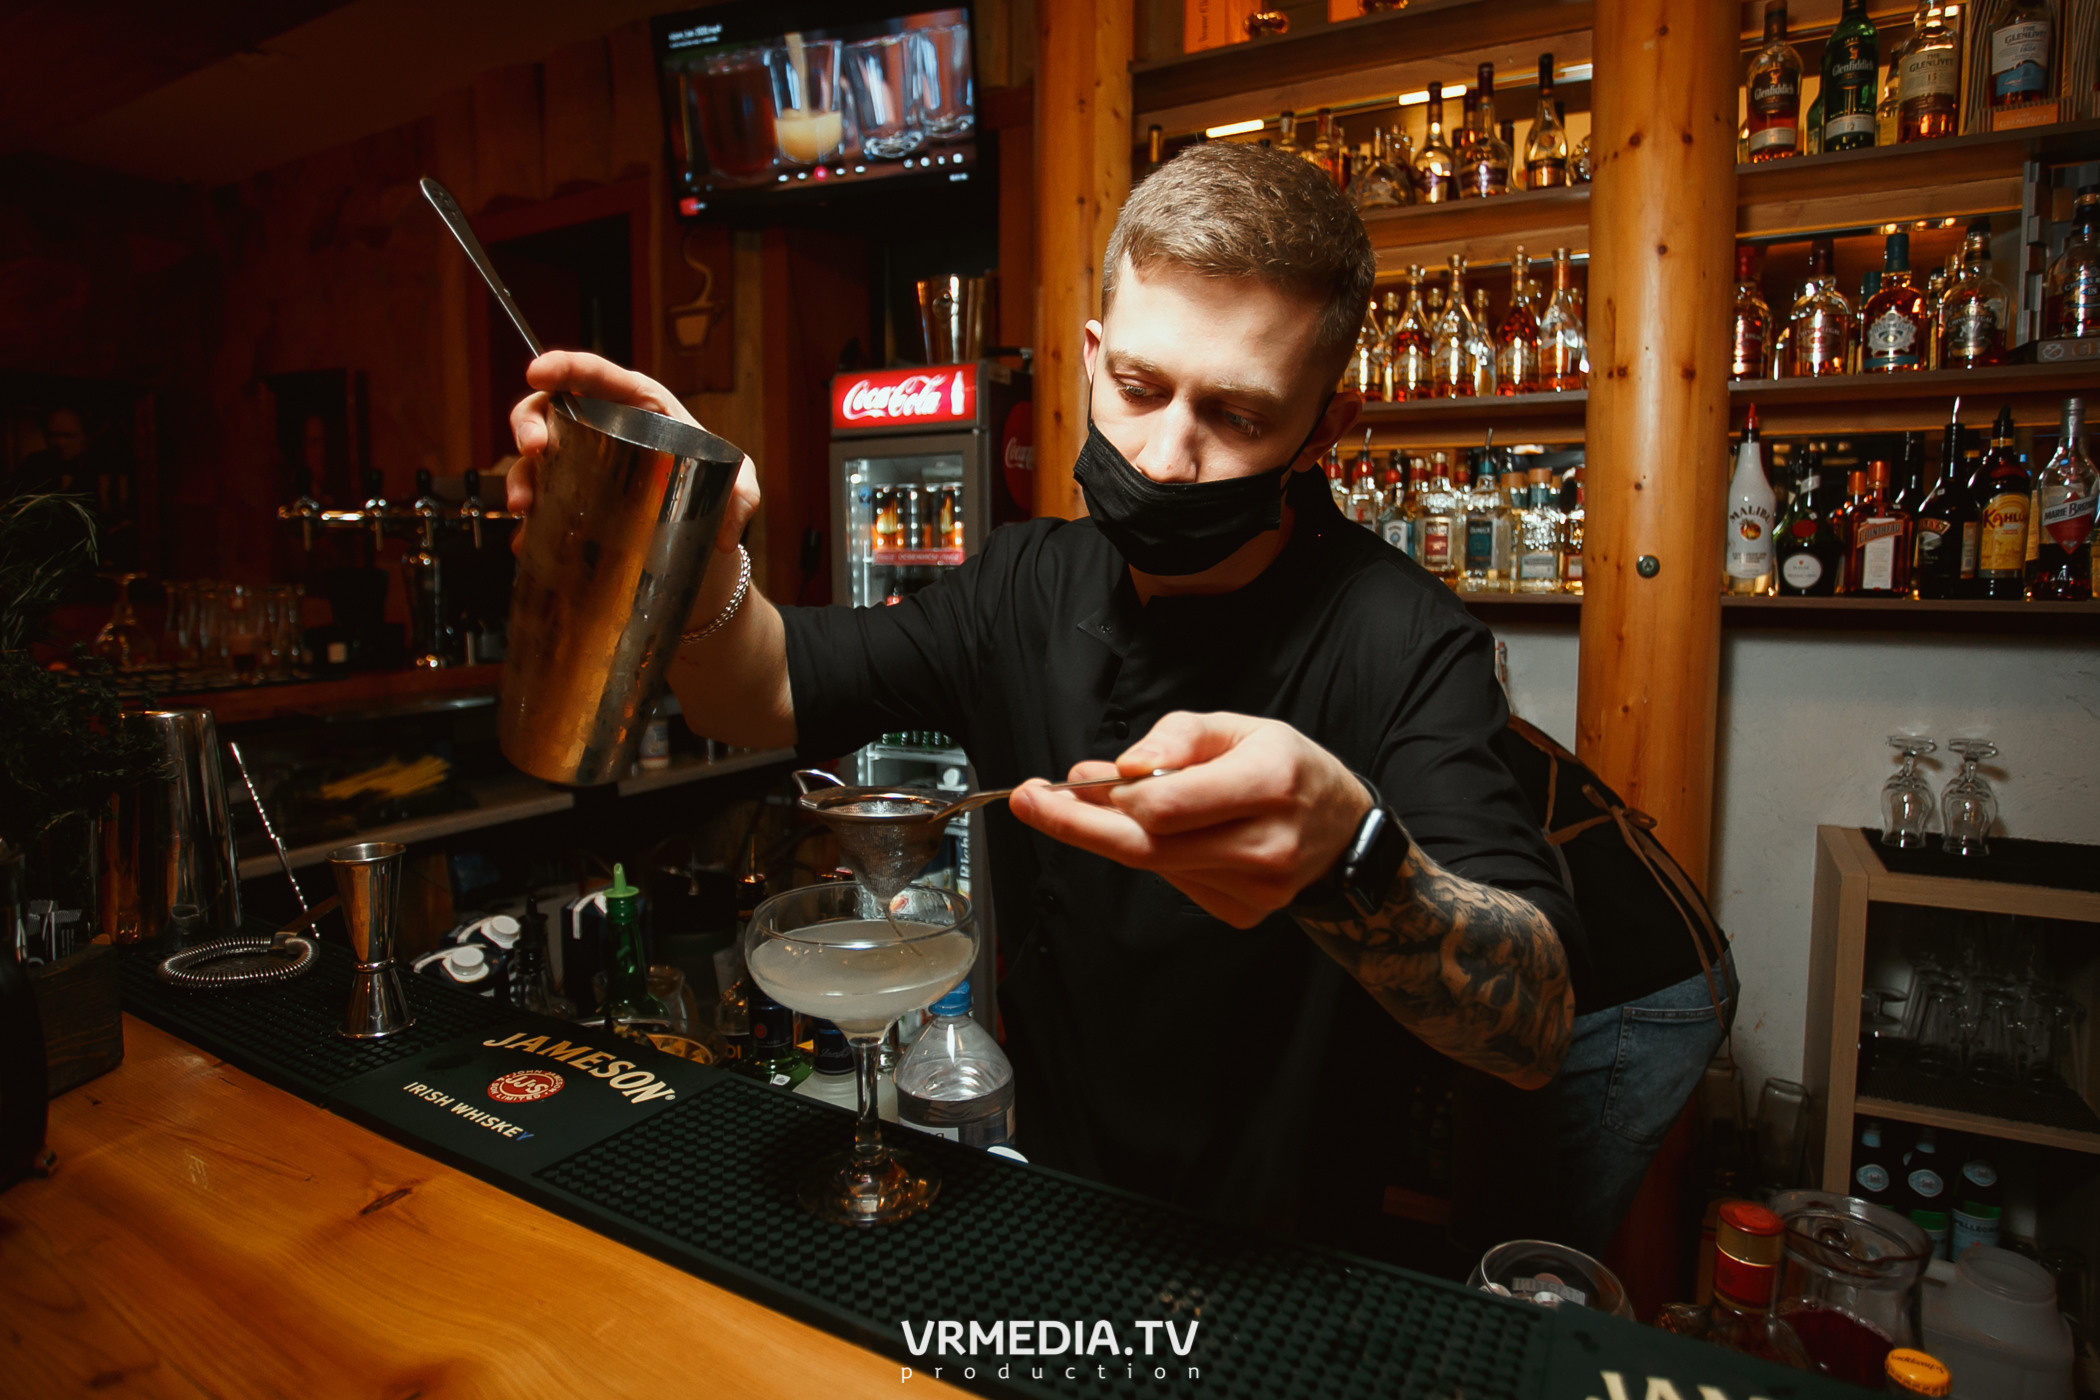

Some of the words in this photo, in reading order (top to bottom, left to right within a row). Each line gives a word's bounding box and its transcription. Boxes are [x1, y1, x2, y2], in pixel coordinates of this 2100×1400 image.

[2004, 30, 2047, 44] GLENLIVET
[2022, 25, 2036, 33] THE
[1926, 52, 1941, 60] THE
[1832, 58, 1874, 77] Glenfiddich
[1909, 57, 1954, 73] GLENLIVET
[1754, 83, 1794, 101] Glenfiddich
[842, 374, 947, 420] Coca-Cola
[2044, 507, 2068, 520] MARIE
[402, 1081, 457, 1109] IRISH
[450, 1100, 534, 1141] WHISKEY
